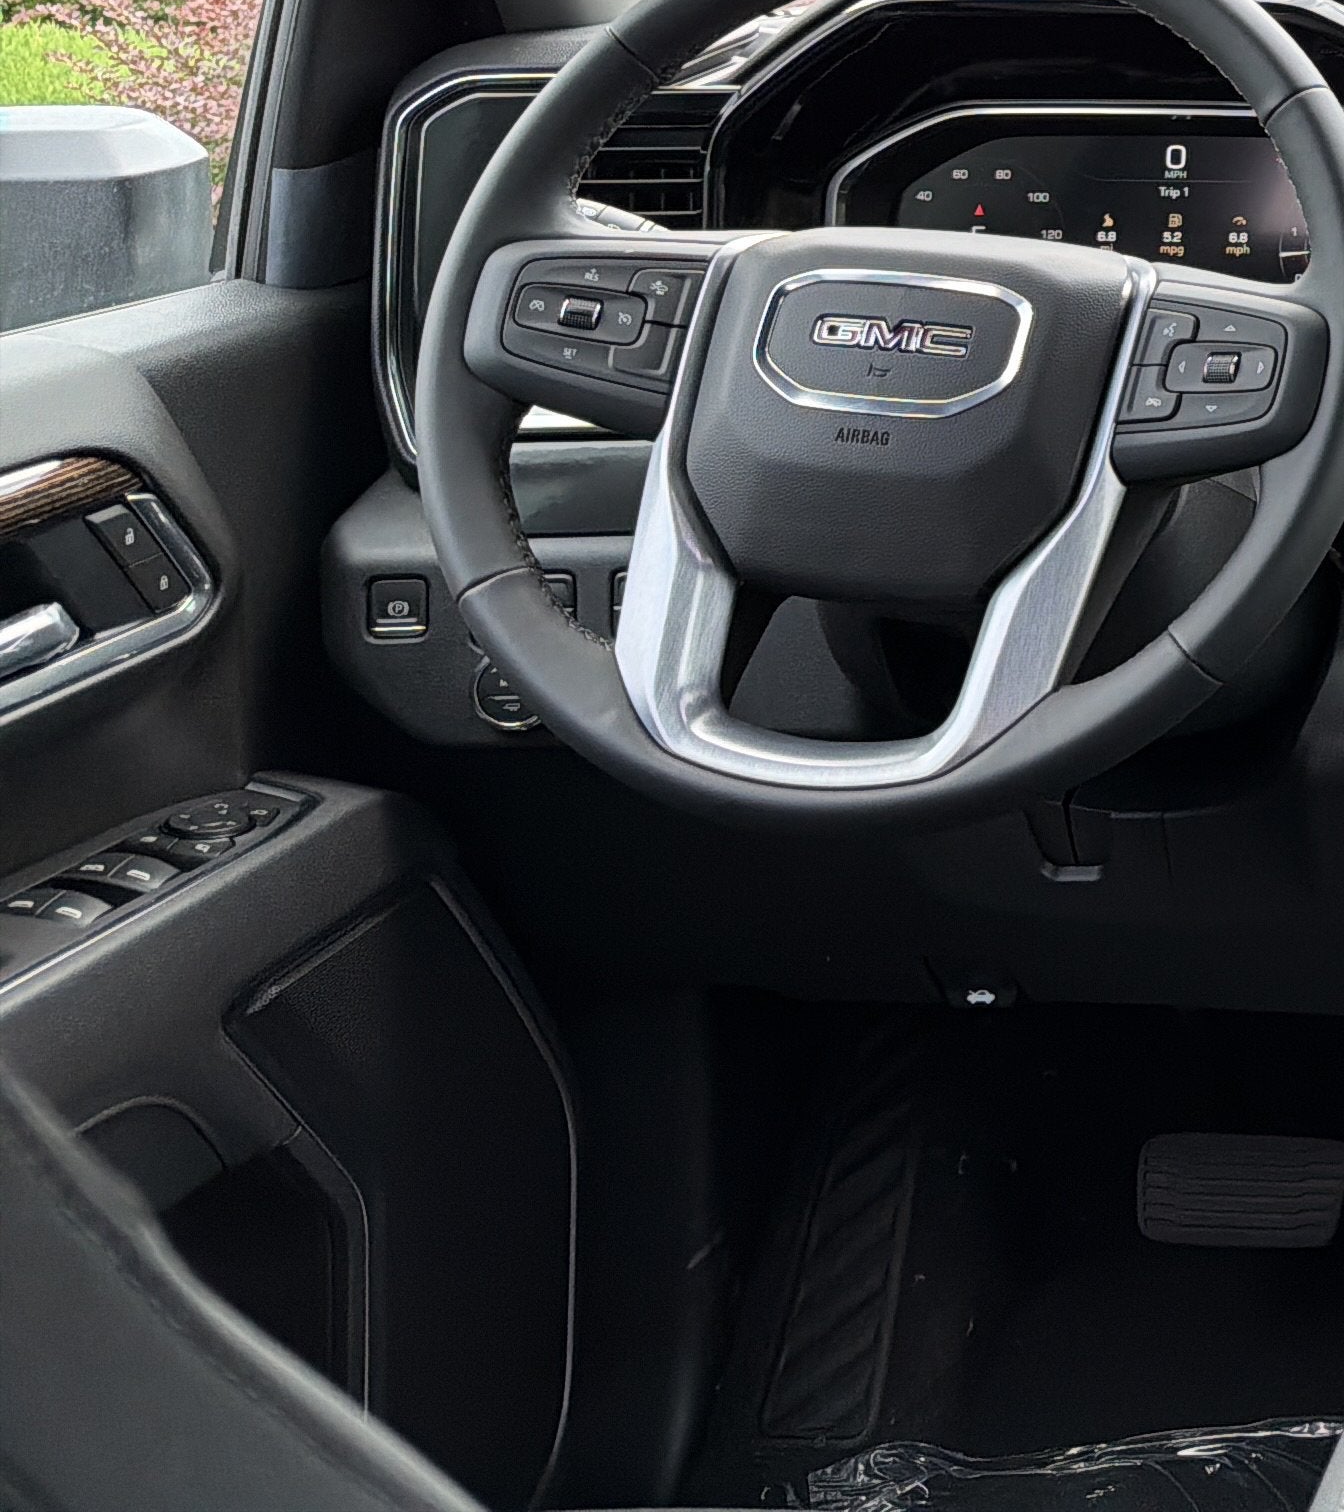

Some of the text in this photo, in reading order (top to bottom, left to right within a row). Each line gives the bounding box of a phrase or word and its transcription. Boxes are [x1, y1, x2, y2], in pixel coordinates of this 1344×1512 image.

[1165, 144, 1187, 170] 0
[952, 169, 969, 180] 60
[995, 169, 1012, 180] 80
[1164, 170, 1188, 179] MPH
[915, 191, 933, 202] 40
[1027, 192, 1050, 203] 100
[1158, 186, 1181, 200] Trip
[1041, 229, 1063, 240] 120
[1096, 231, 1117, 243] 6.8
[1162, 231, 1183, 243] 5.2
[1228, 232, 1248, 244] 6.8
[1159, 245, 1185, 257] mpg
[1225, 243, 1251, 257] mph
[809, 313, 976, 360] GMC
[834, 427, 891, 446] AIRBAG
